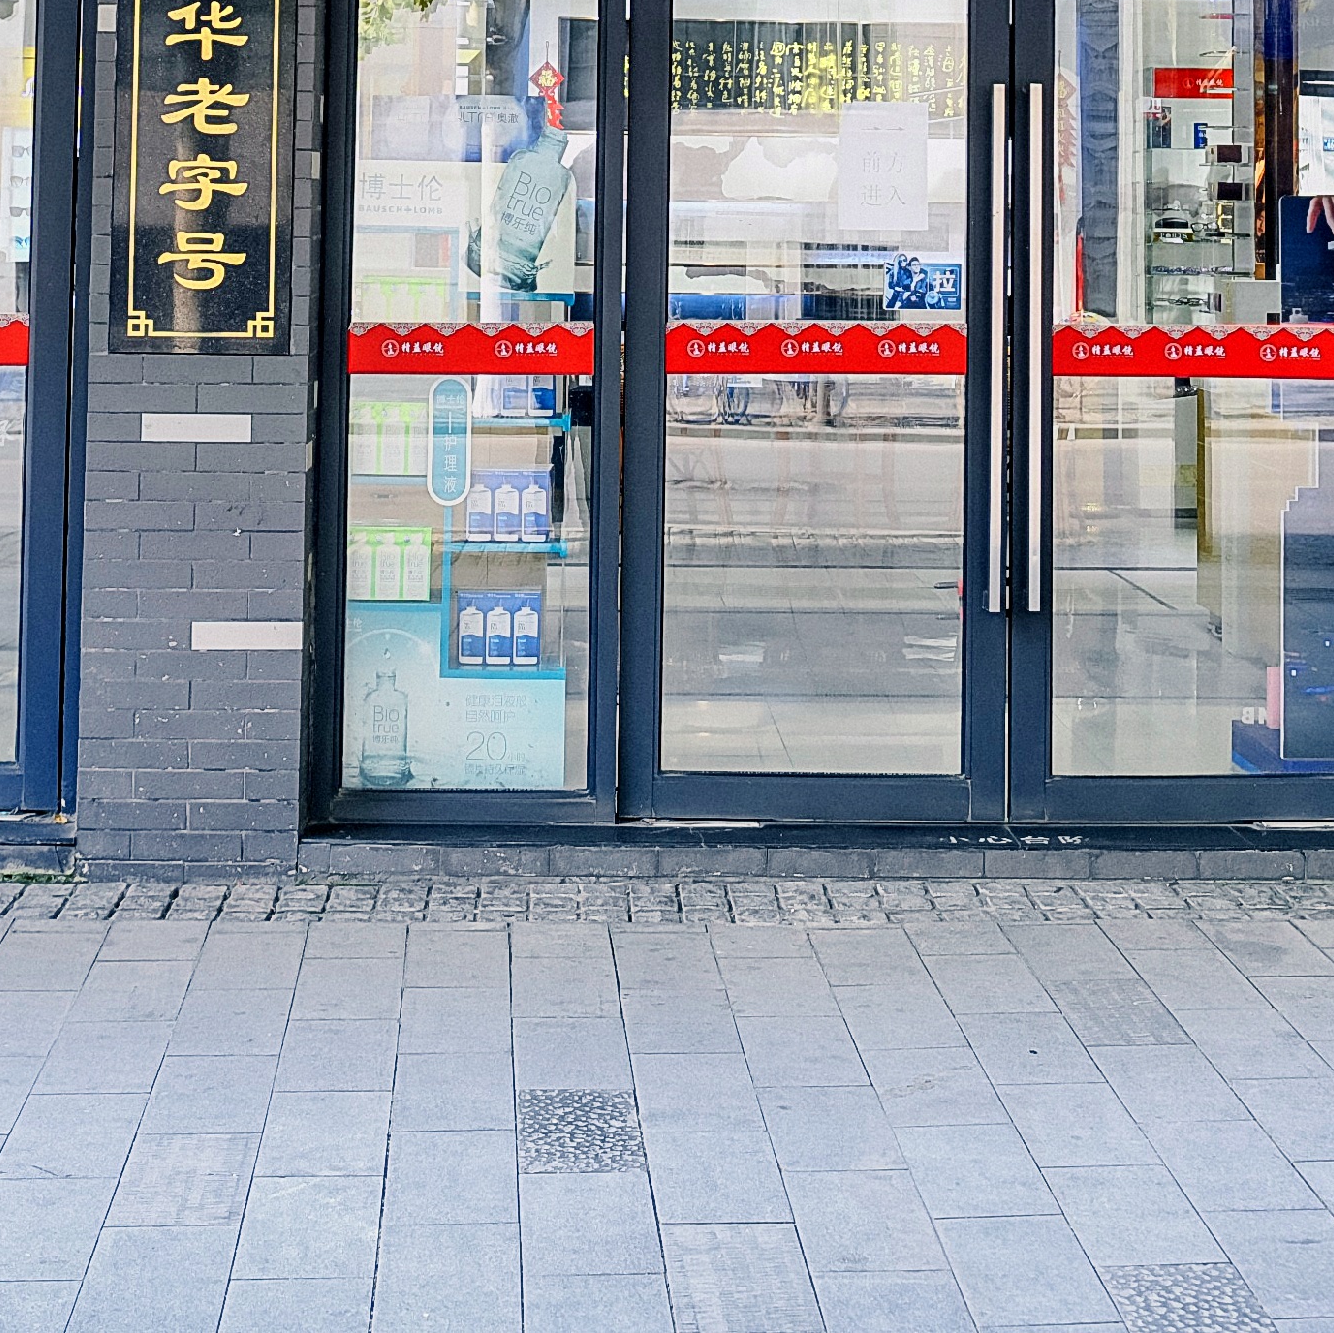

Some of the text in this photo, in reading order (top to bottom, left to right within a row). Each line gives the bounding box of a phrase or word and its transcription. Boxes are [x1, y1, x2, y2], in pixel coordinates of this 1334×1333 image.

[862, 150, 904, 174] 前方
[359, 172, 443, 202] 博士伦
[860, 184, 906, 207] 进入
[506, 193, 545, 221] true
[500, 210, 538, 235] 博乐纯
[933, 269, 956, 293] 拉
[443, 434, 458, 494] 护理液
[373, 722, 400, 734] true
